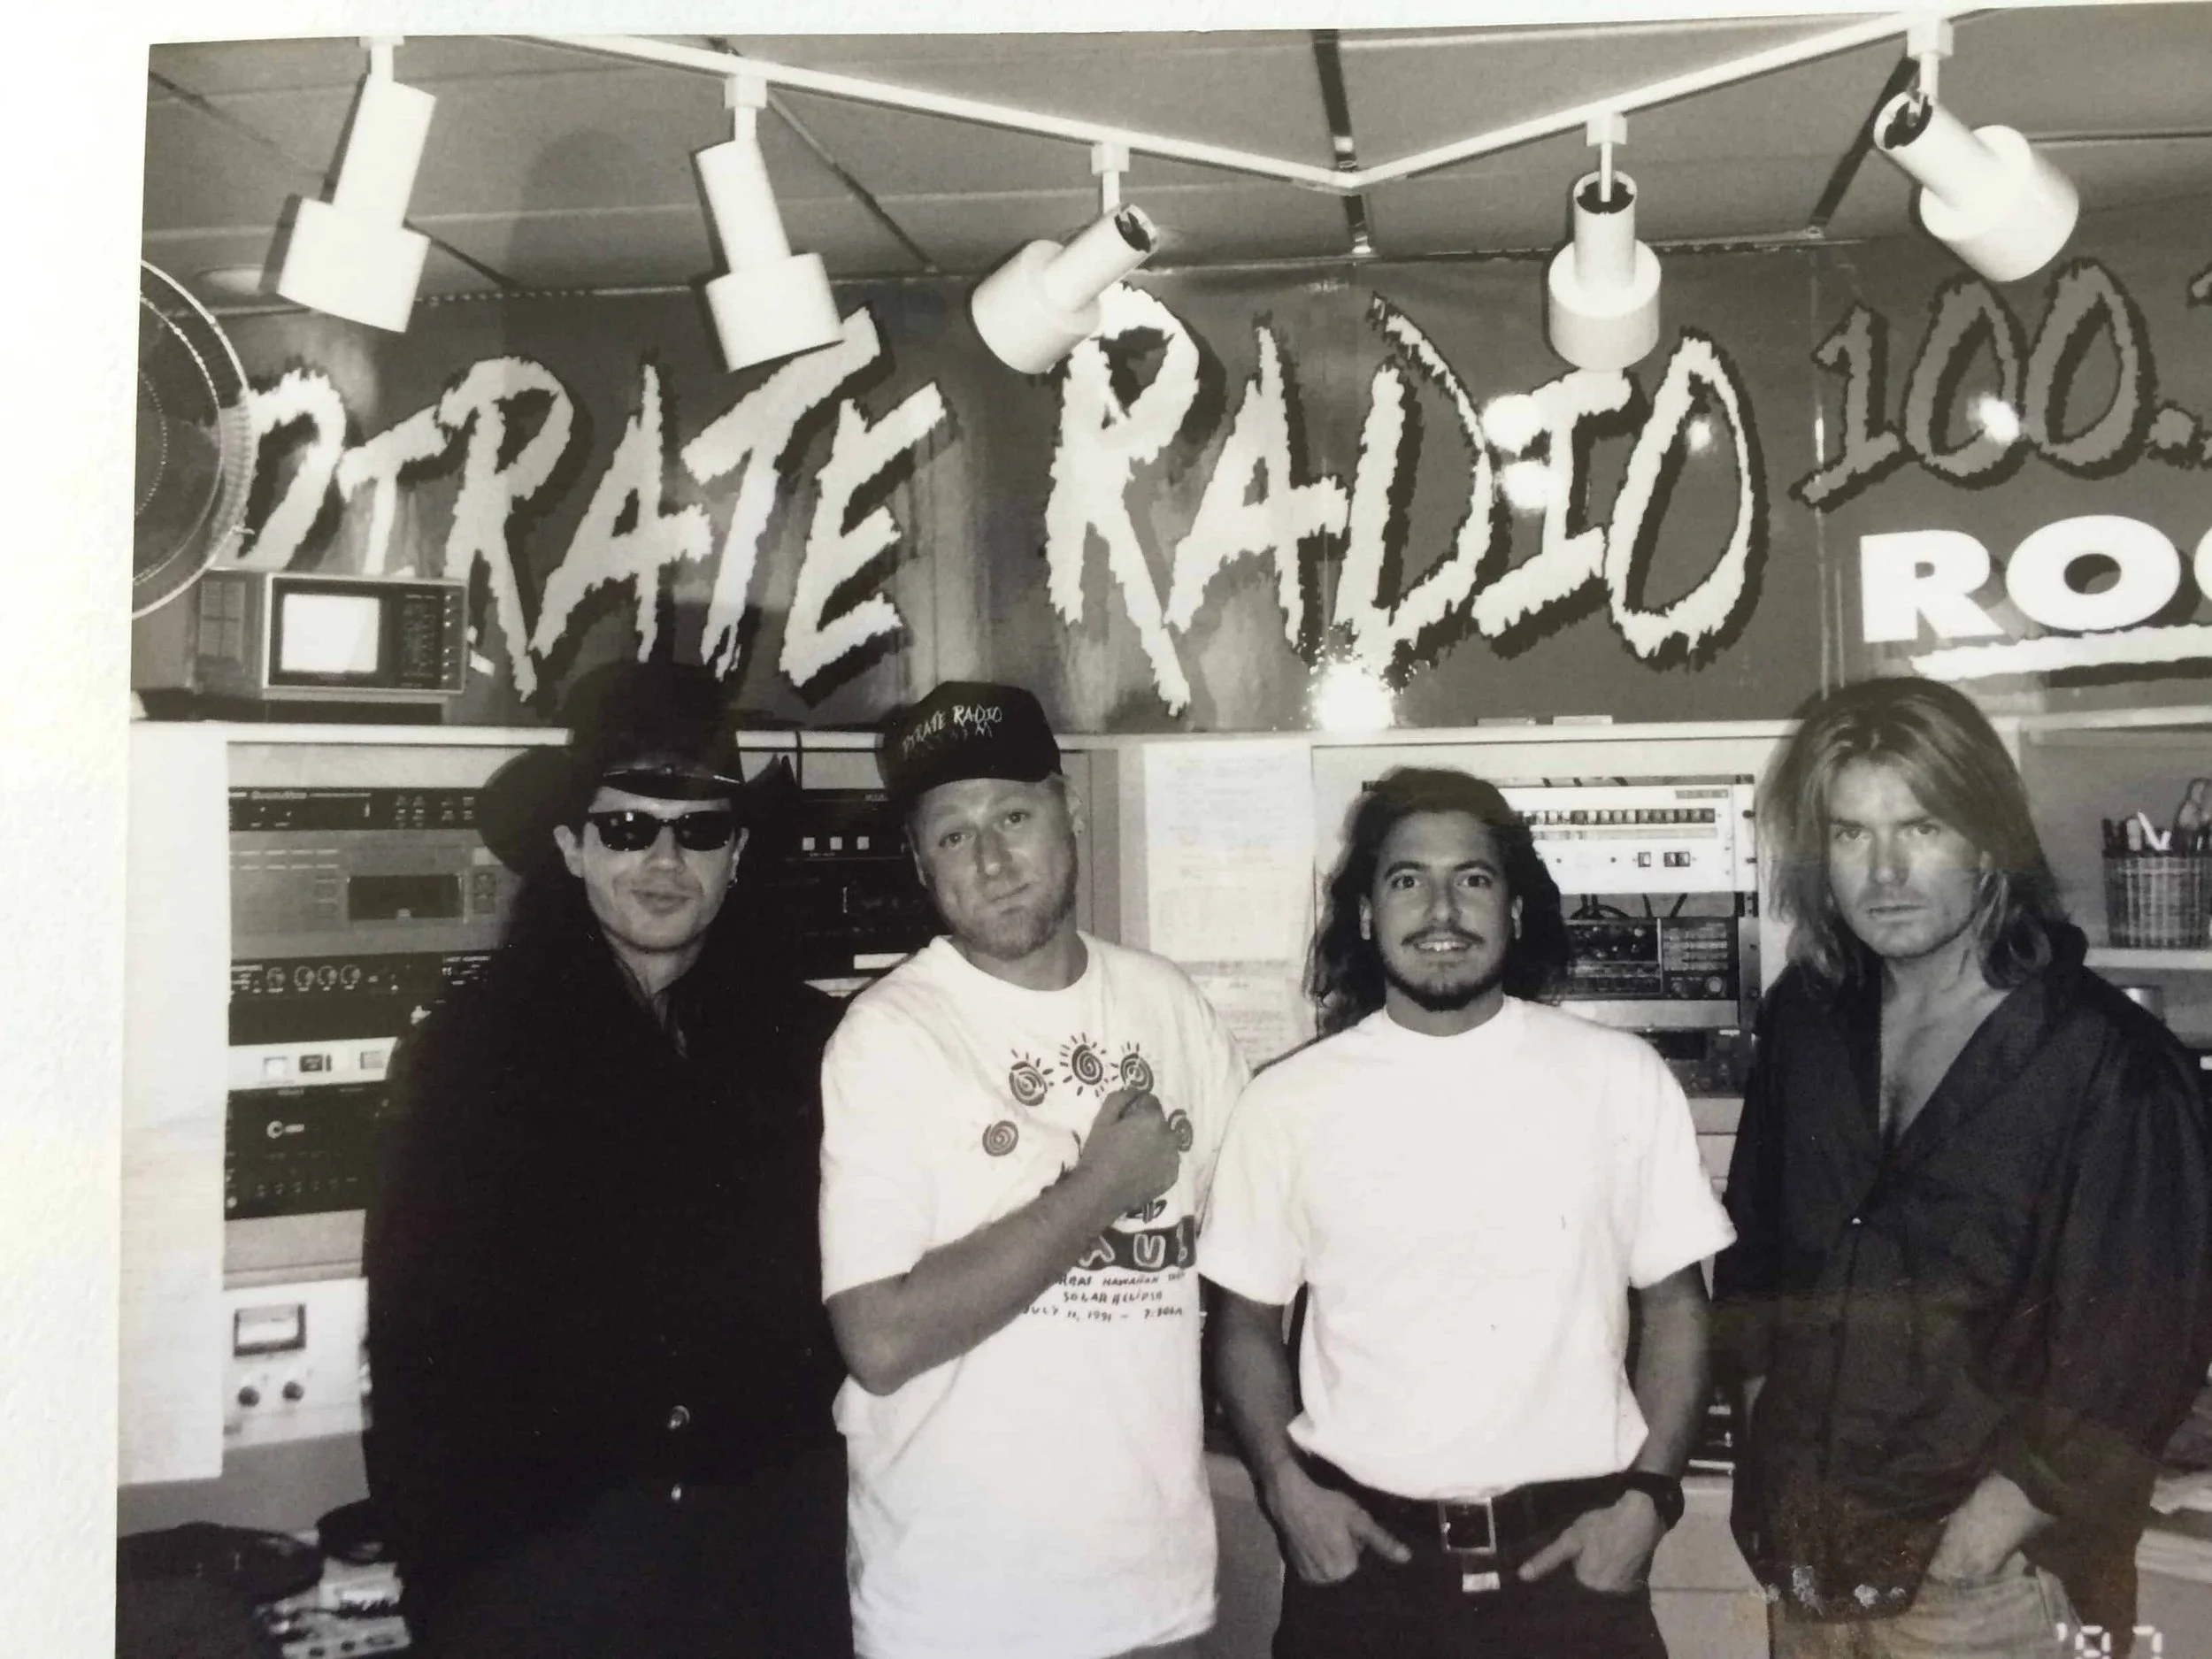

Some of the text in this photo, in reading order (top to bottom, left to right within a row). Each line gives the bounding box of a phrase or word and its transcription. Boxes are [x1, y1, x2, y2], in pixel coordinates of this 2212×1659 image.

[1794, 260, 2212, 510] 100.
[1046, 281, 1754, 717] RADIO
[951, 703, 1002, 726] RADIO
[1064, 1291, 1108, 1304] SOLAR
